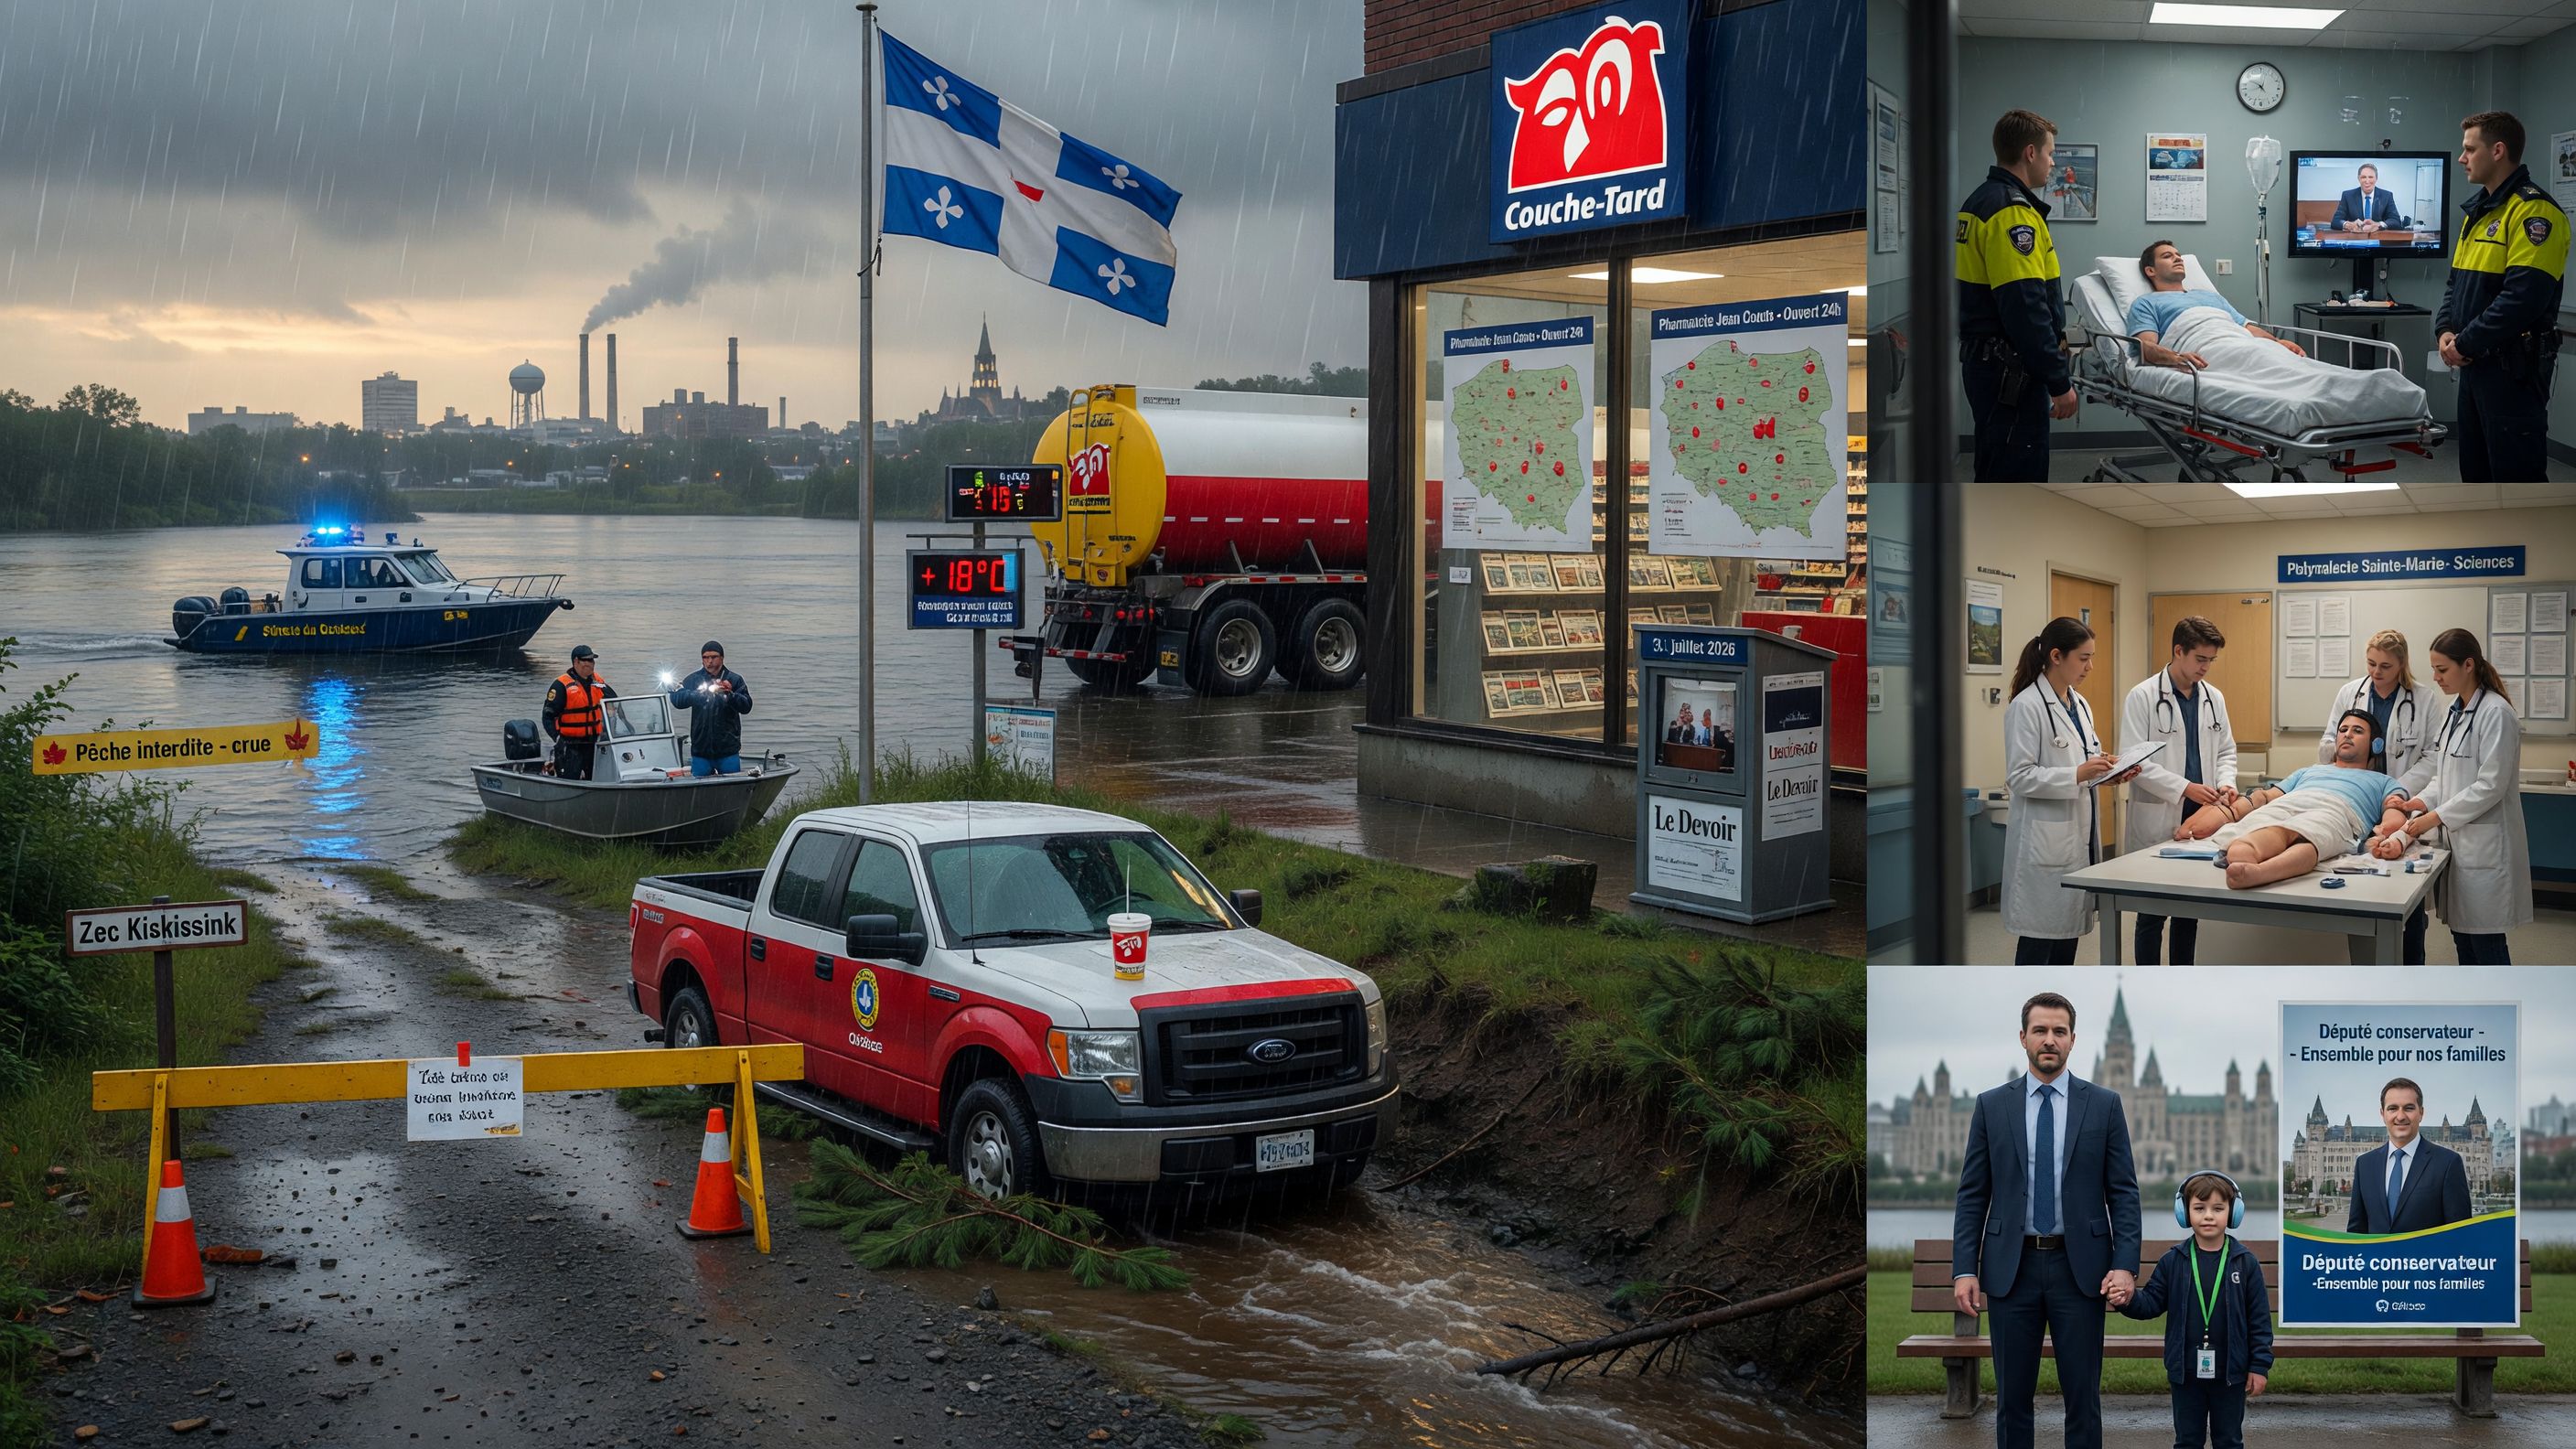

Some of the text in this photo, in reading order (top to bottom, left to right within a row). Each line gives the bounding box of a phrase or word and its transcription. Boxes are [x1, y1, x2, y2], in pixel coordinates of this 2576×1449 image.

[1505, 177, 1667, 231] Couche-Tard
[2453, 554, 2515, 571] Sciences
[1707, 640, 1735, 656] 2026
[76, 742, 131, 762] Pêche
[137, 738, 213, 759] interdite
[231, 738, 272, 754] crue
[1655, 805, 1736, 842] Le Devoir
[80, 912, 237, 944] Zec Kiskissink
[2319, 1023, 2372, 1042] Député
[2376, 1024, 2474, 1039] conservateur
[2301, 1046, 2374, 1062] Ensemble
[2377, 1049, 2412, 1065] pour
[2416, 1048, 2442, 1062] nos
[2446, 1046, 2506, 1062] familles
[2302, 1253, 2366, 1273] Député
[2382, 1279, 2410, 1293] pour
[2414, 1280, 2436, 1290] nos
